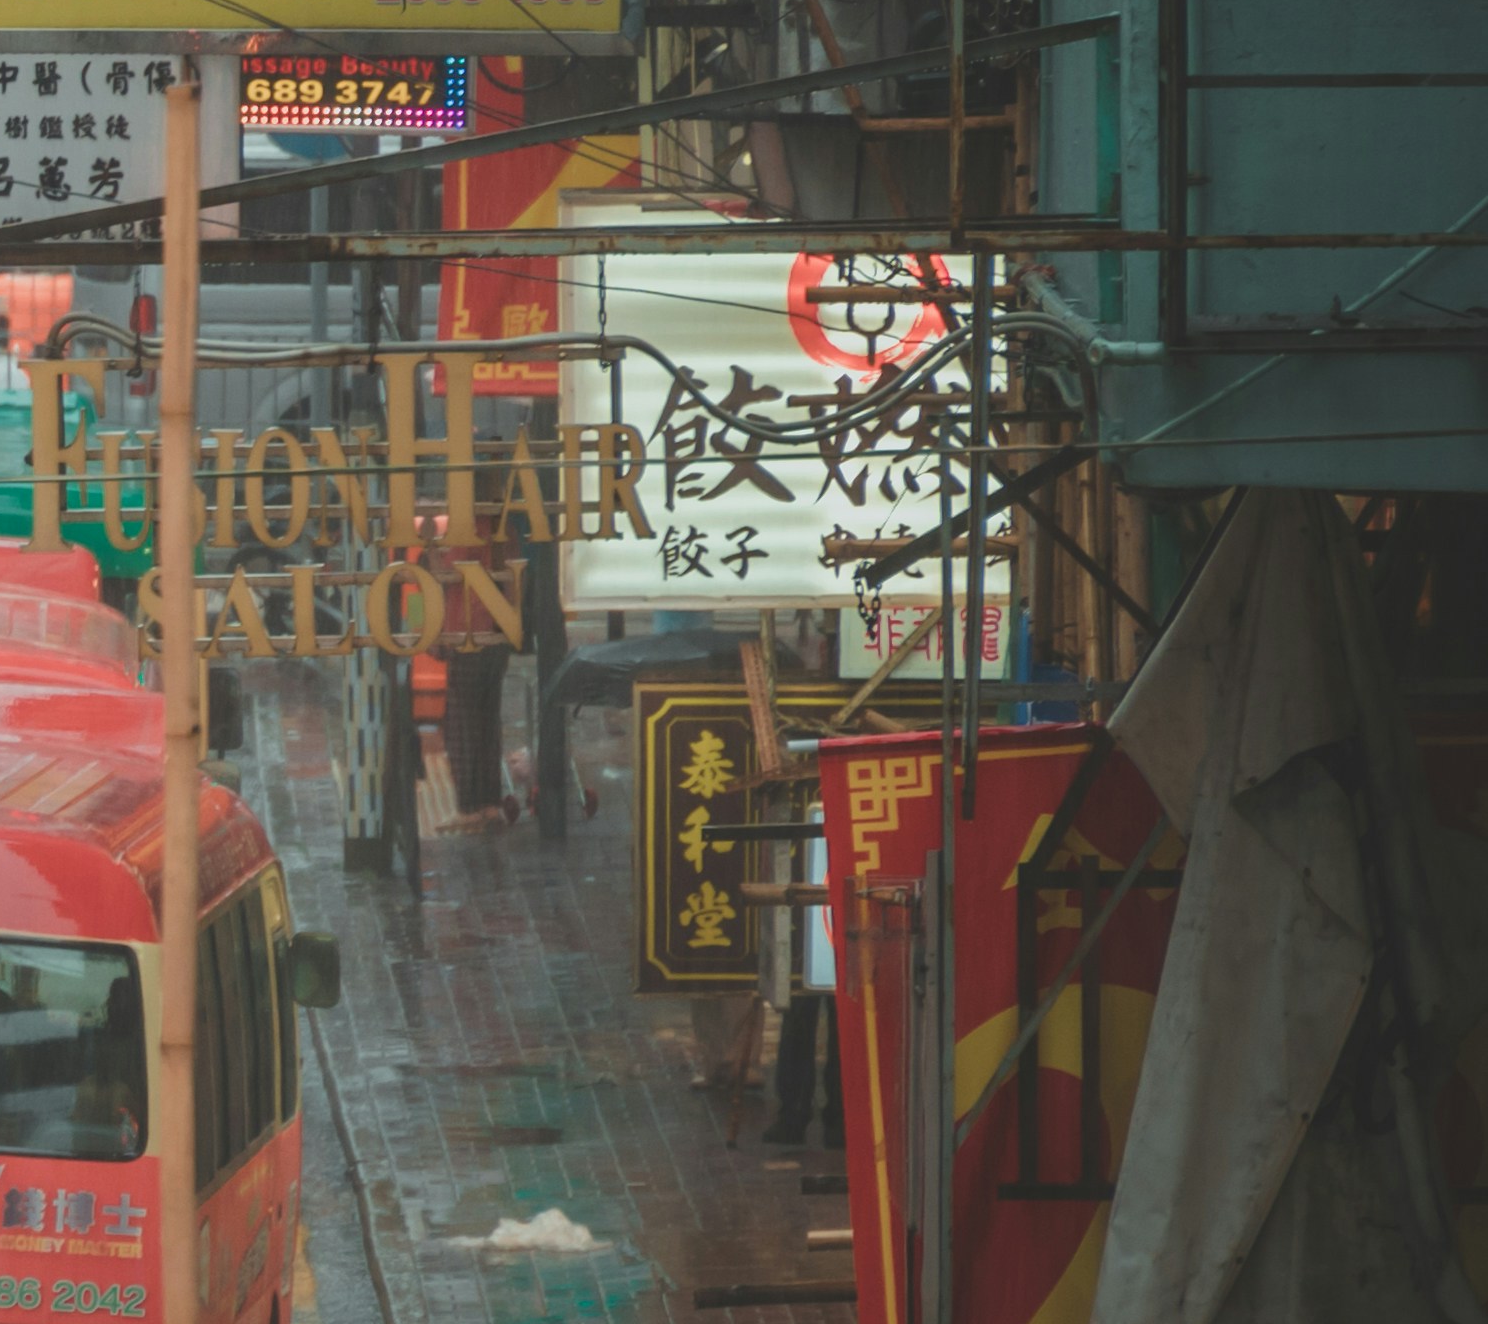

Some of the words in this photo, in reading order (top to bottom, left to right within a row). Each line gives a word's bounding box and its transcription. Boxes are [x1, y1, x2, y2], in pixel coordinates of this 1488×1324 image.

[247, 80, 325, 105] 689
[335, 79, 435, 105] 3747
[18, 359, 376, 553] FUION
[378, 352, 656, 550] HAIR
[658, 525, 769, 581] 餃子
[677, 729, 737, 948] 泰和堂
[1, 1186, 148, 1238] 錢博士
[68, 1236, 144, 1260] MASTER
[51, 1279, 146, 1318] 2042
